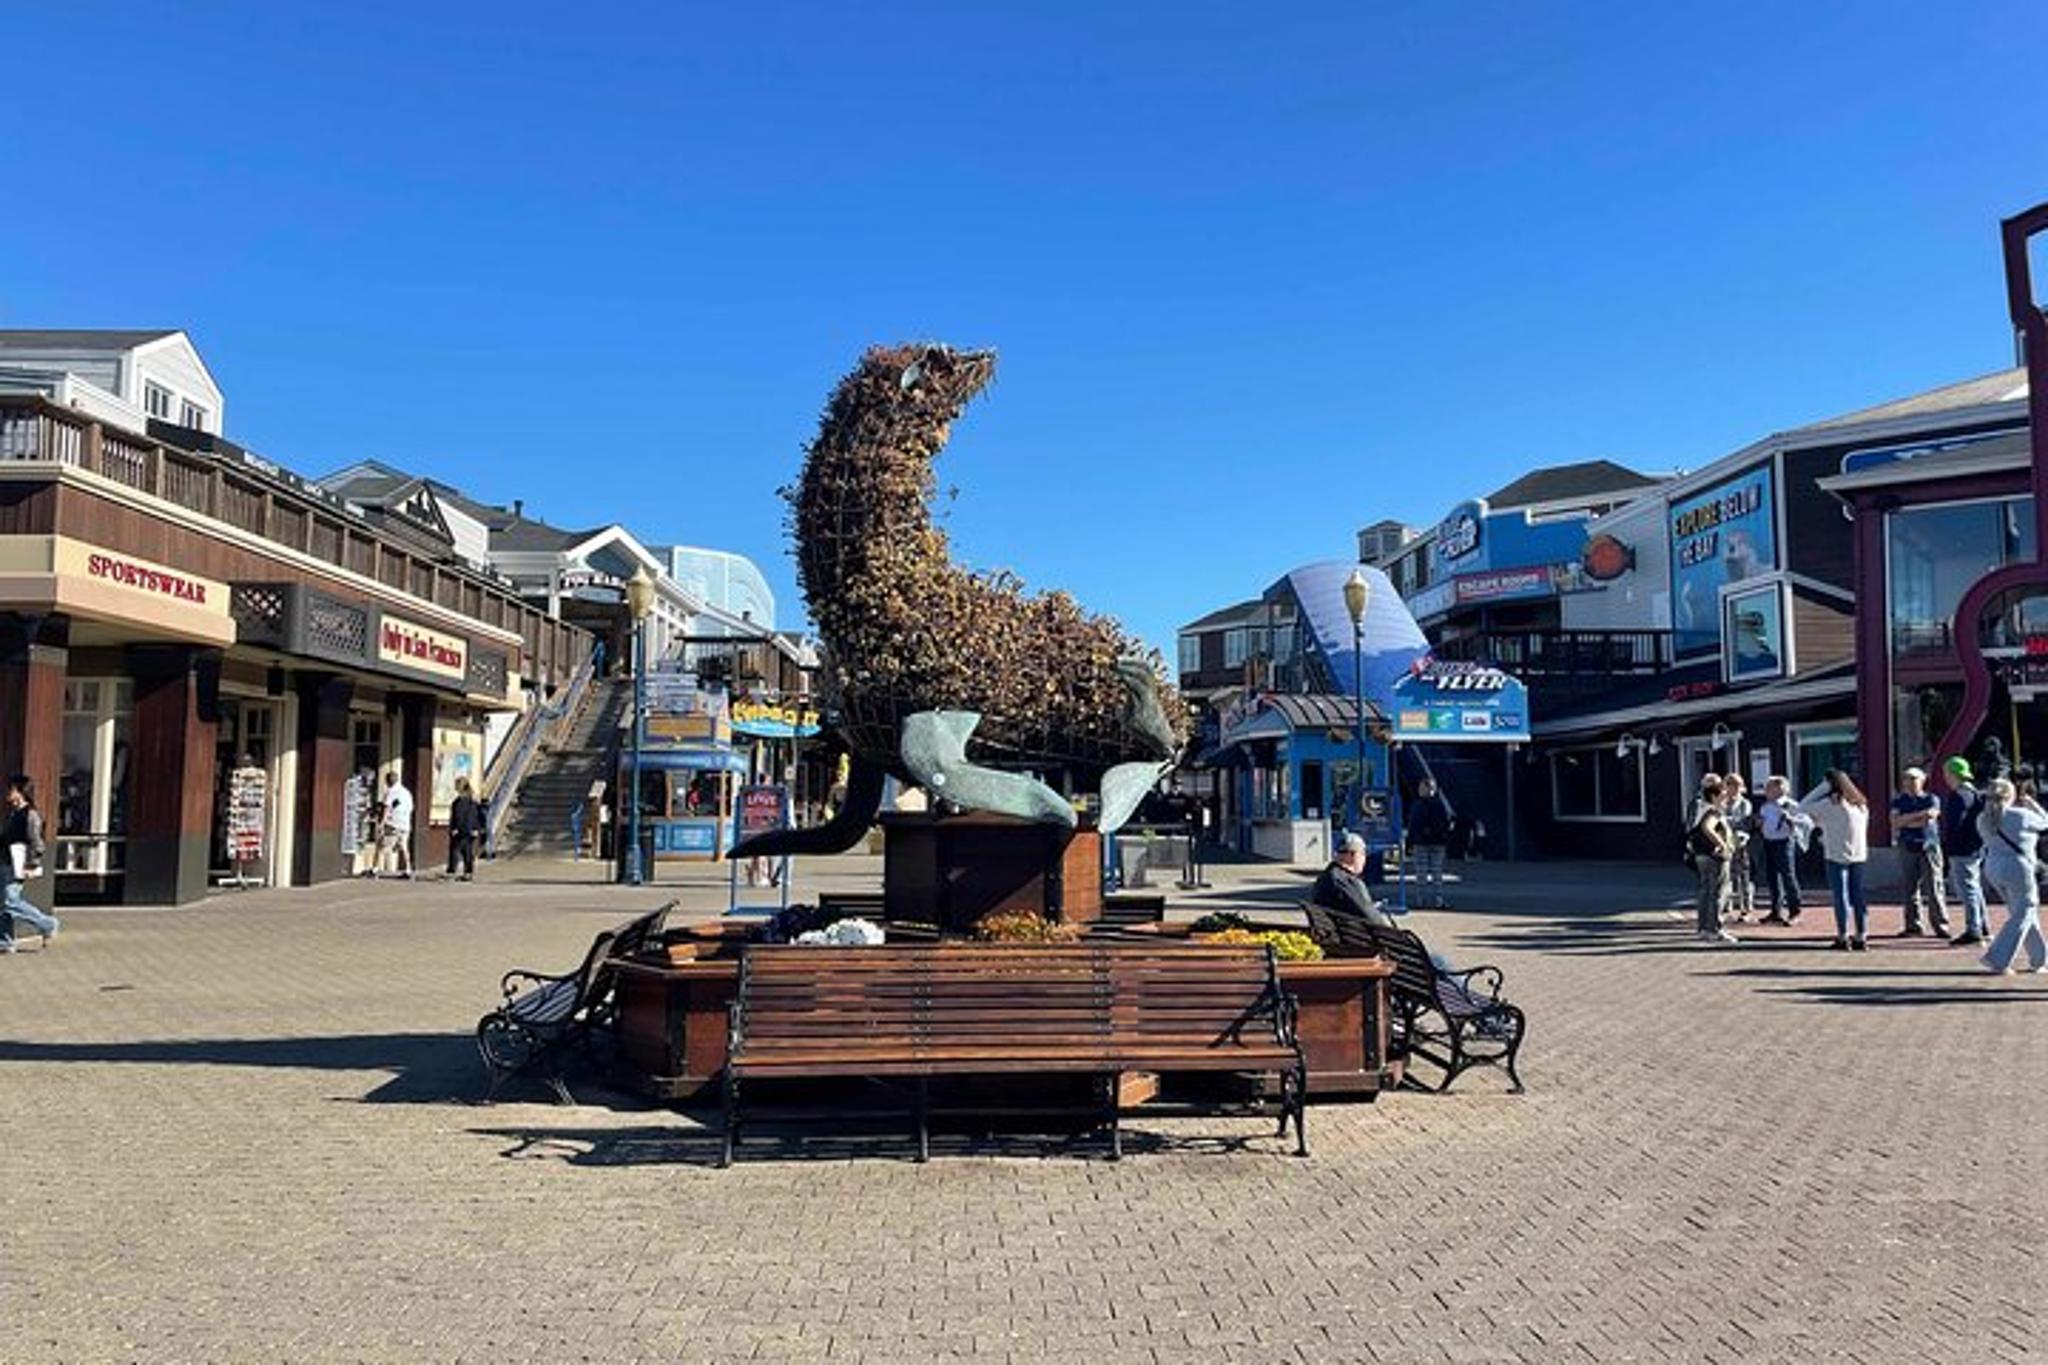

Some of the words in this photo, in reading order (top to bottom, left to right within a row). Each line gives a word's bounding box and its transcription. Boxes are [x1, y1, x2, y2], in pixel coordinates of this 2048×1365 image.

[1676, 500, 1720, 536] EXPLORE
[1721, 484, 1761, 523] BELOW
[1695, 532, 1718, 561] BAY
[88, 553, 206, 604] SPORTSWEAR
[1458, 579, 1500, 593] ESCAPE
[383, 622, 402, 660] Only
[412, 631, 427, 659] San
[428, 636, 461, 669] Francisco
[1436, 674, 1505, 690] FLYER
